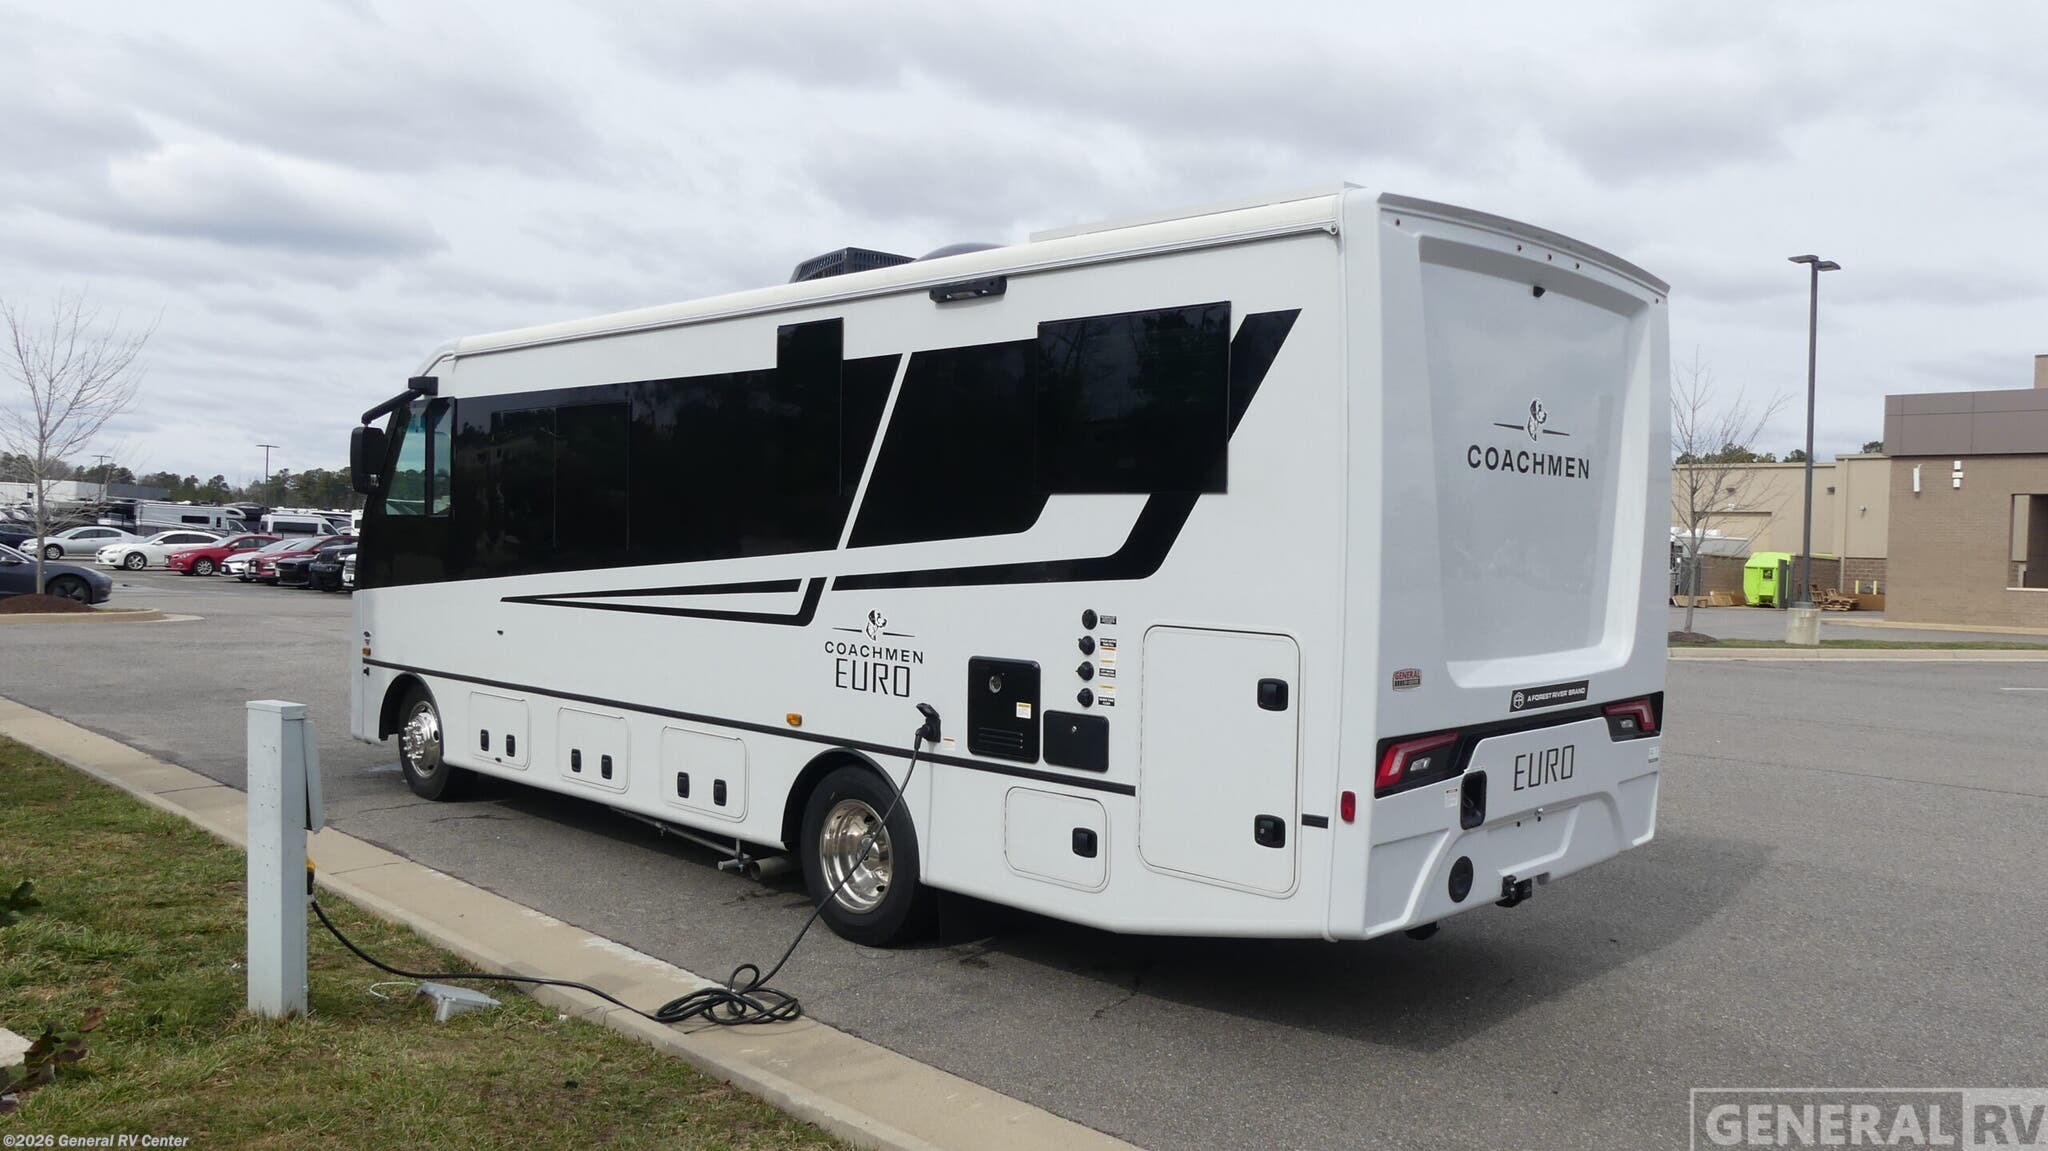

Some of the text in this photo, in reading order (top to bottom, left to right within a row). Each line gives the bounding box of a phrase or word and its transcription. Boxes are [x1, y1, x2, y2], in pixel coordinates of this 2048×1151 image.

[1467, 444, 1589, 479] COACHMEN
[825, 640, 924, 665] COACHMEN
[835, 658, 911, 698] EURO
[1395, 670, 1420, 680] GENERAL
[1532, 692, 1551, 701] FOREST
[1552, 690, 1567, 698] RIVER
[1568, 687, 1585, 696] BRAND
[1513, 744, 1575, 791] EURO
